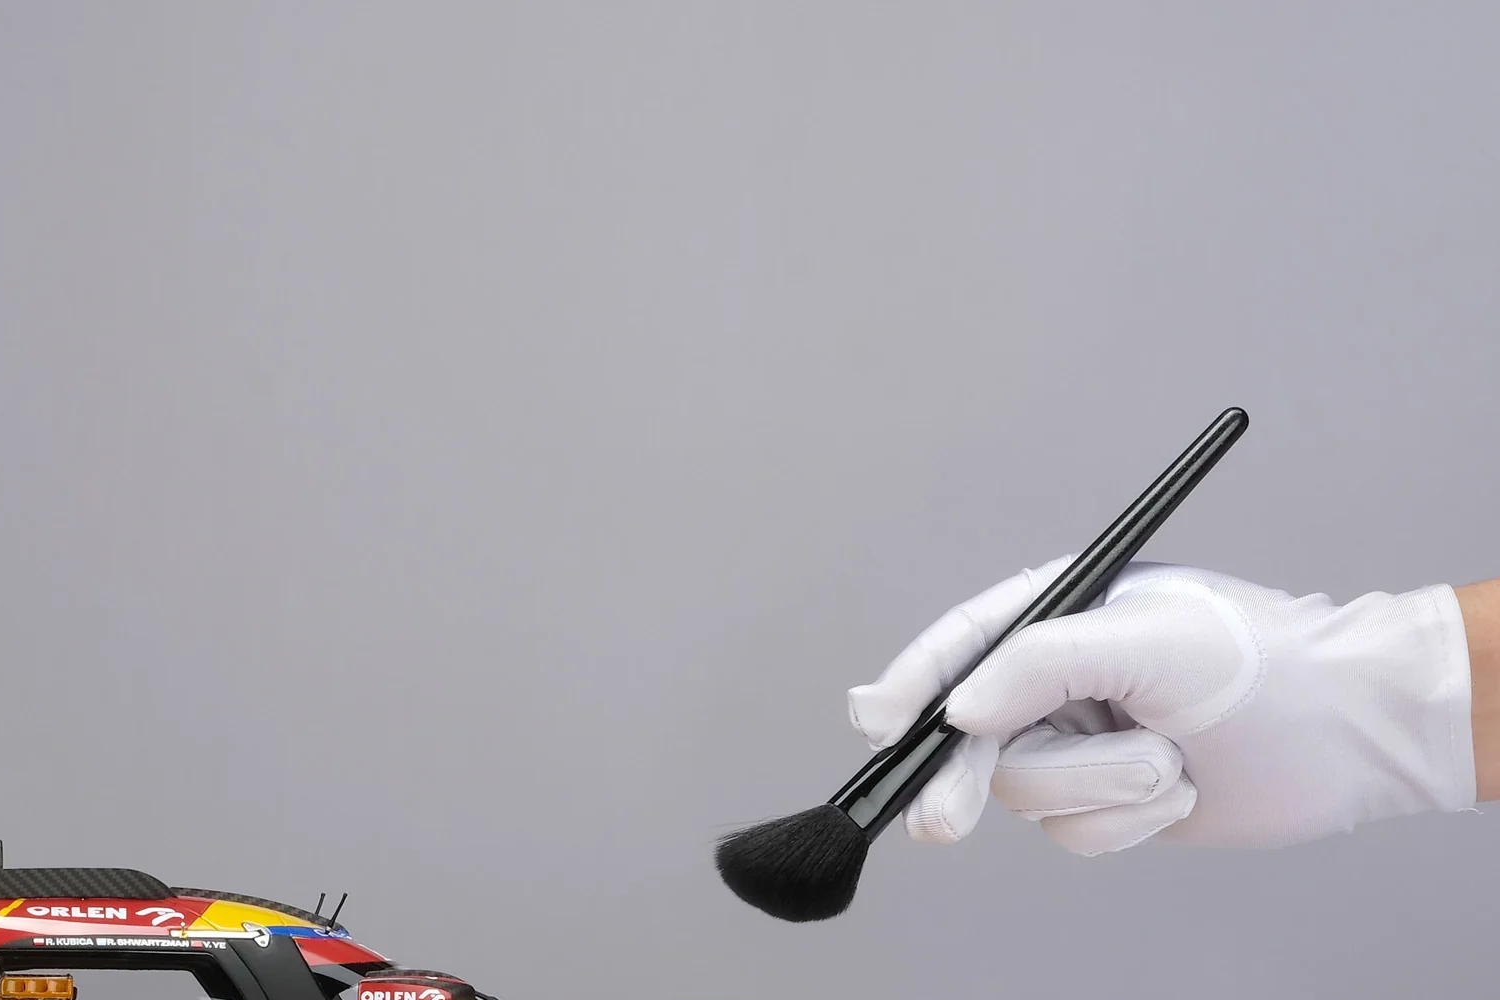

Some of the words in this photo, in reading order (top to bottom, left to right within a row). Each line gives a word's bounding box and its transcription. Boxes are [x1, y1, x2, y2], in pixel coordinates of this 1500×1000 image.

[27, 906, 127, 920] ORLEN
[56, 938, 94, 946] KUBICA
[118, 939, 189, 948] SHWARTZMAN
